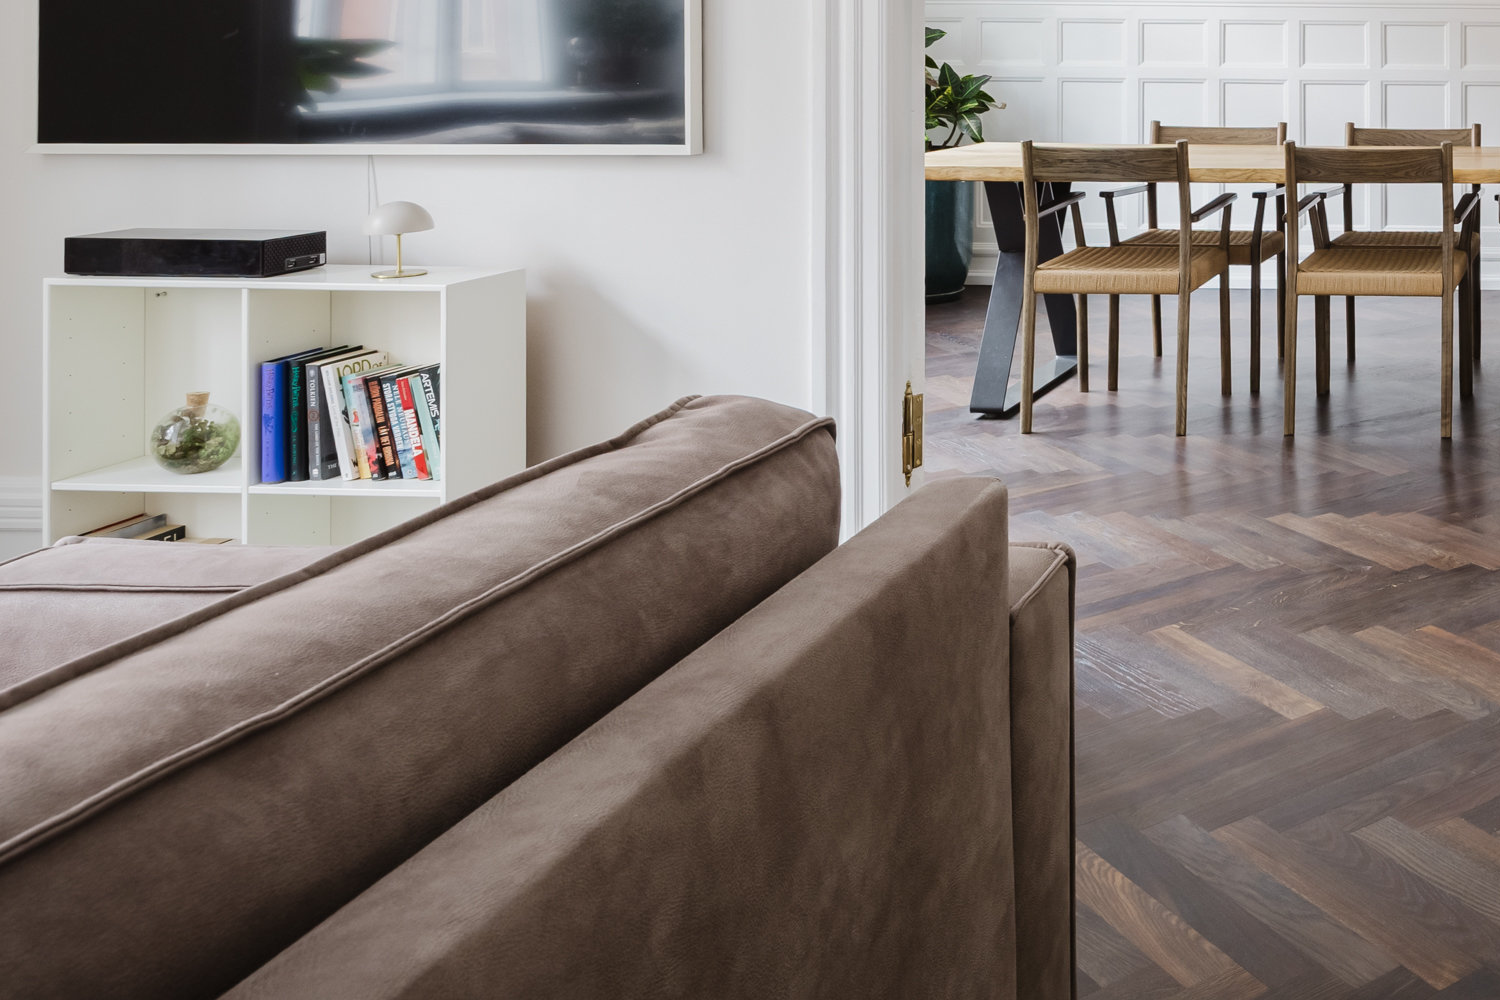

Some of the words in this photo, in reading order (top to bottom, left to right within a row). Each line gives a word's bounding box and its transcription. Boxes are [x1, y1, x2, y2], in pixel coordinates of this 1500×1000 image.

[292, 366, 300, 386] HARRY
[382, 382, 393, 402] STORA
[392, 385, 400, 404] NELE
[420, 373, 440, 418] ARTEMIS
[386, 402, 398, 426] STYGGA
[404, 408, 423, 457] MANDELA
